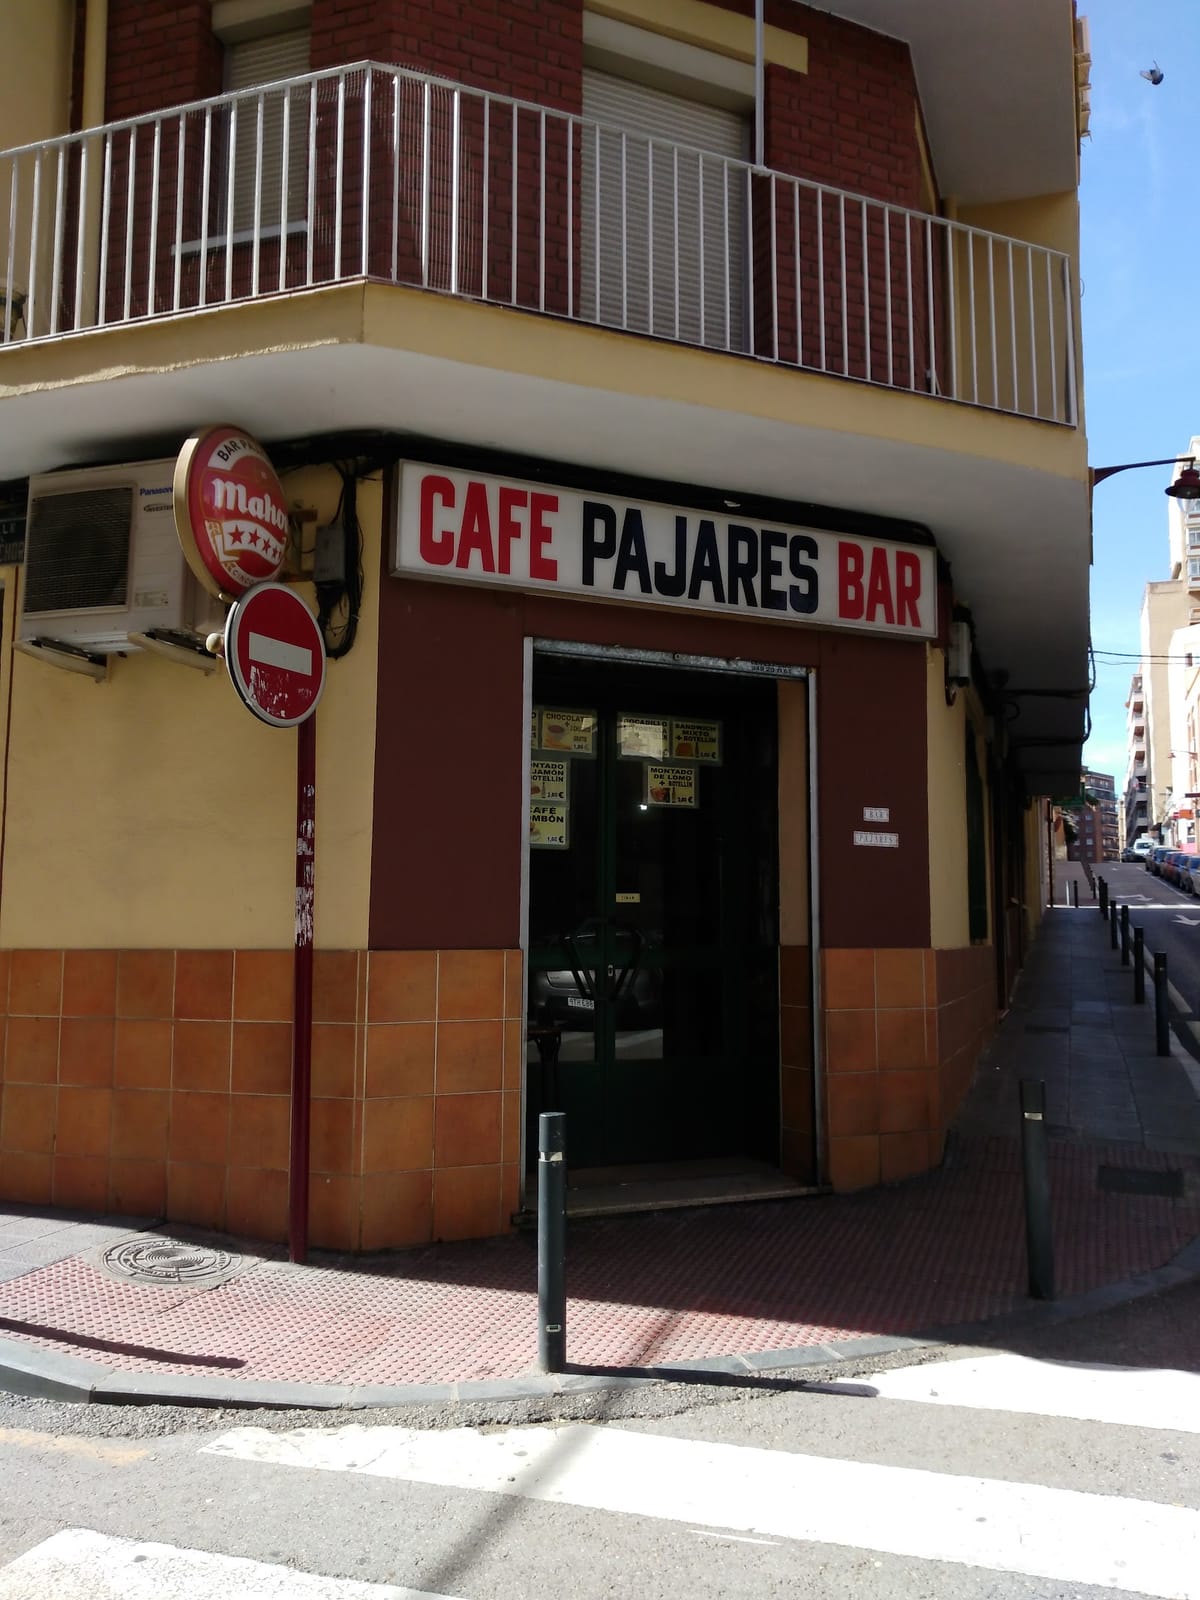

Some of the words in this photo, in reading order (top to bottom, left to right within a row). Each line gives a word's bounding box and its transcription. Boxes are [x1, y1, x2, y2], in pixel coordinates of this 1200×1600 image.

[217, 440, 242, 463] BAR
[419, 475, 559, 582] CAFE
[582, 500, 819, 615] PAJARES
[837, 541, 921, 628] BAR
[531, 763, 564, 771] NTADO
[651, 768, 693, 777] MONTADO
[668, 775, 692, 783] LOMO
[530, 815, 564, 824] MBÓN
